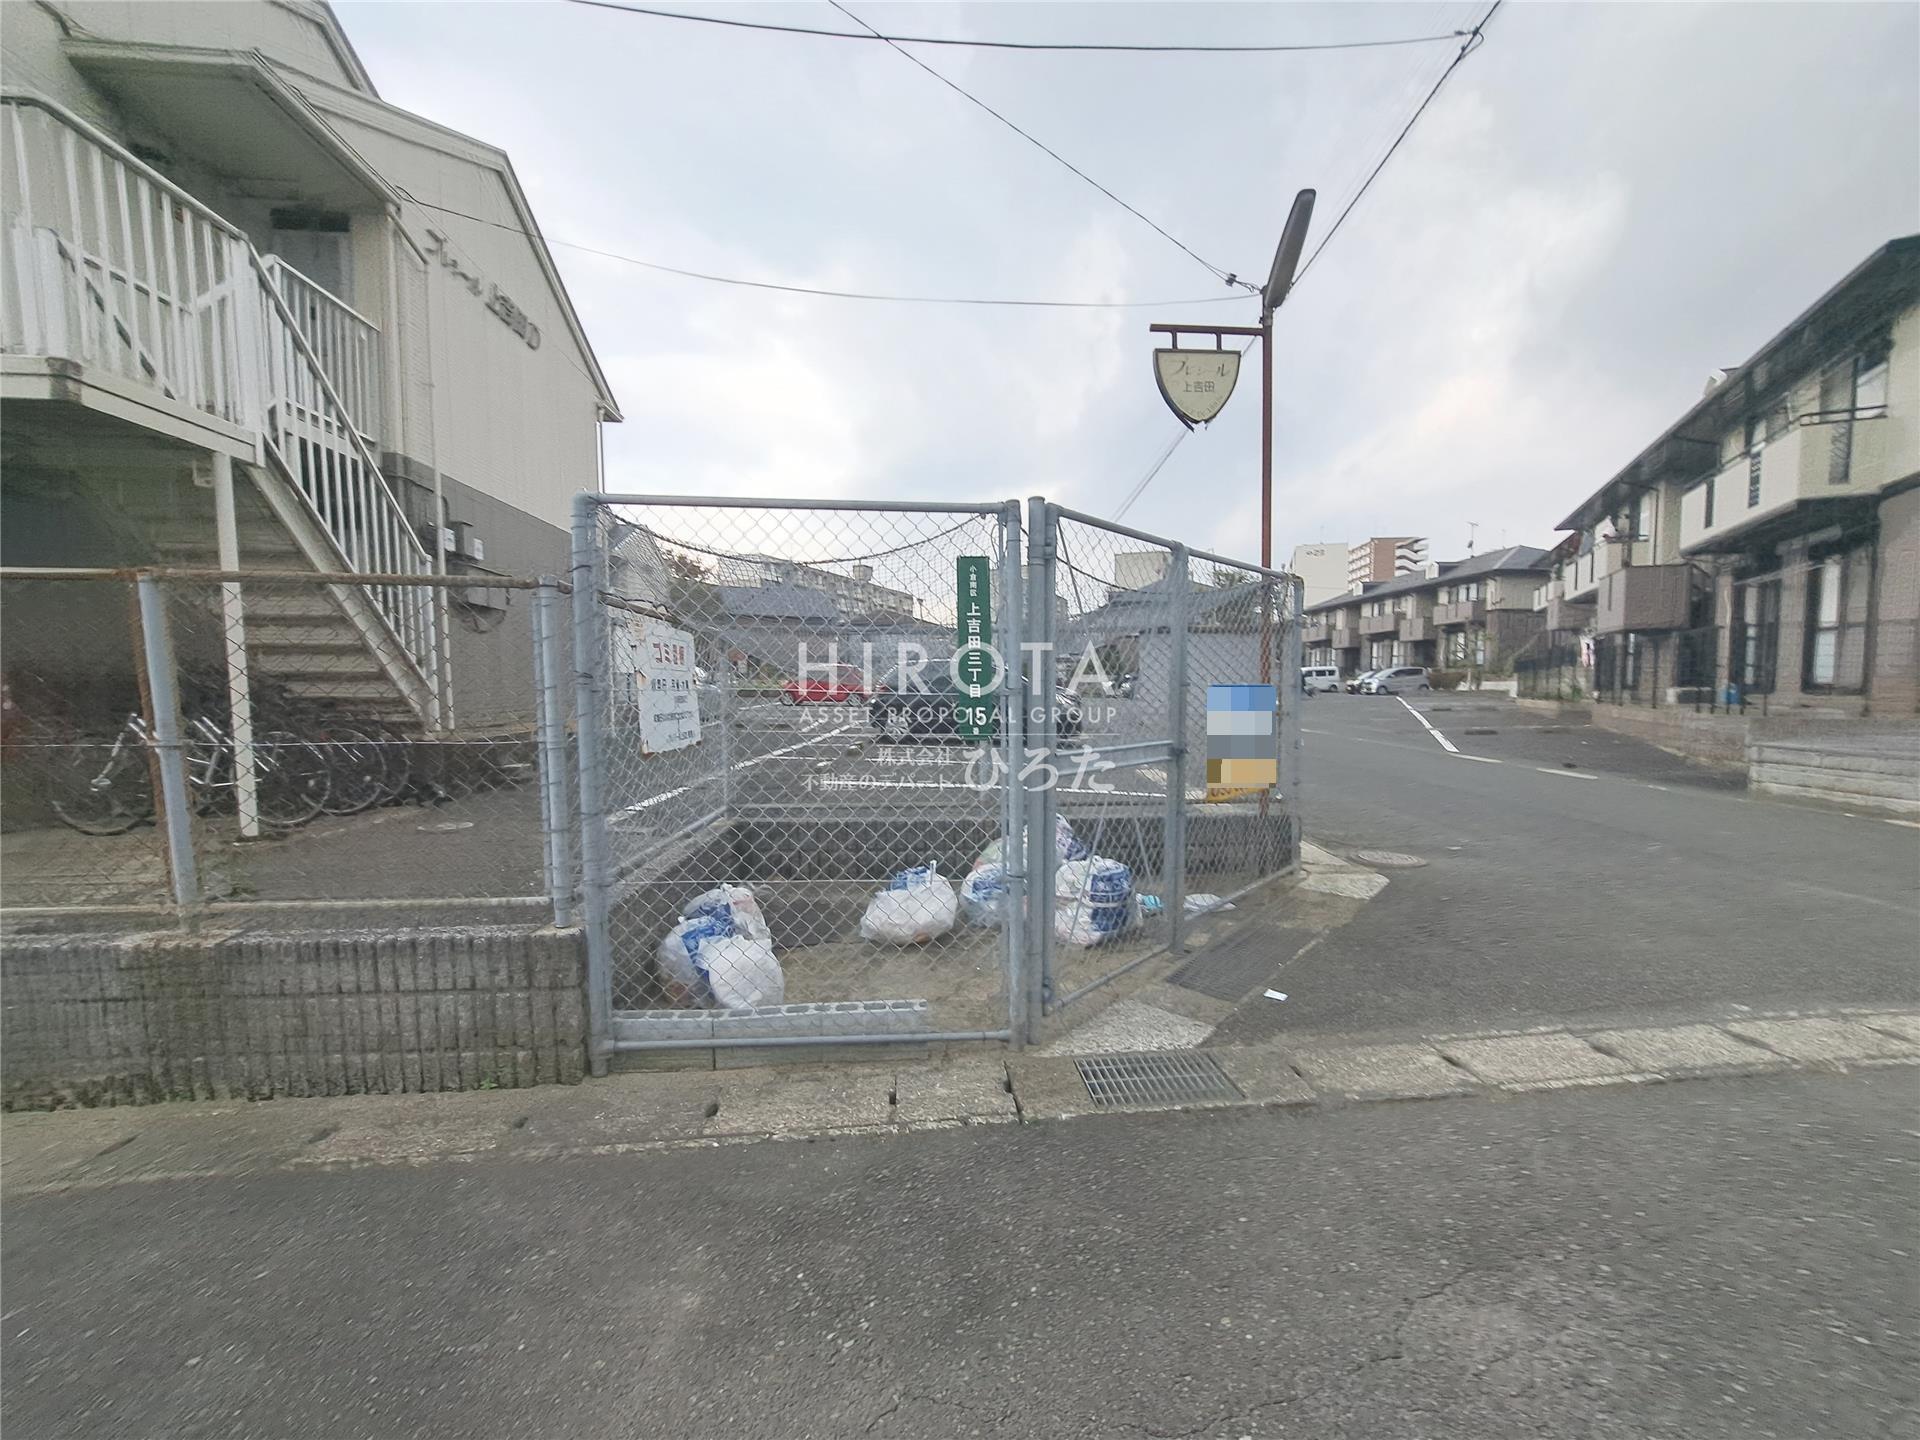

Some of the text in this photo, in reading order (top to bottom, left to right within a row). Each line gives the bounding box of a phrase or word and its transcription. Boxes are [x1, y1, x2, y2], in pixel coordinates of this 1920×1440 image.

[1182, 381, 1215, 392] 上吉田
[966, 602, 982, 698] 上吉田三丁目
[967, 706, 987, 726] 15
